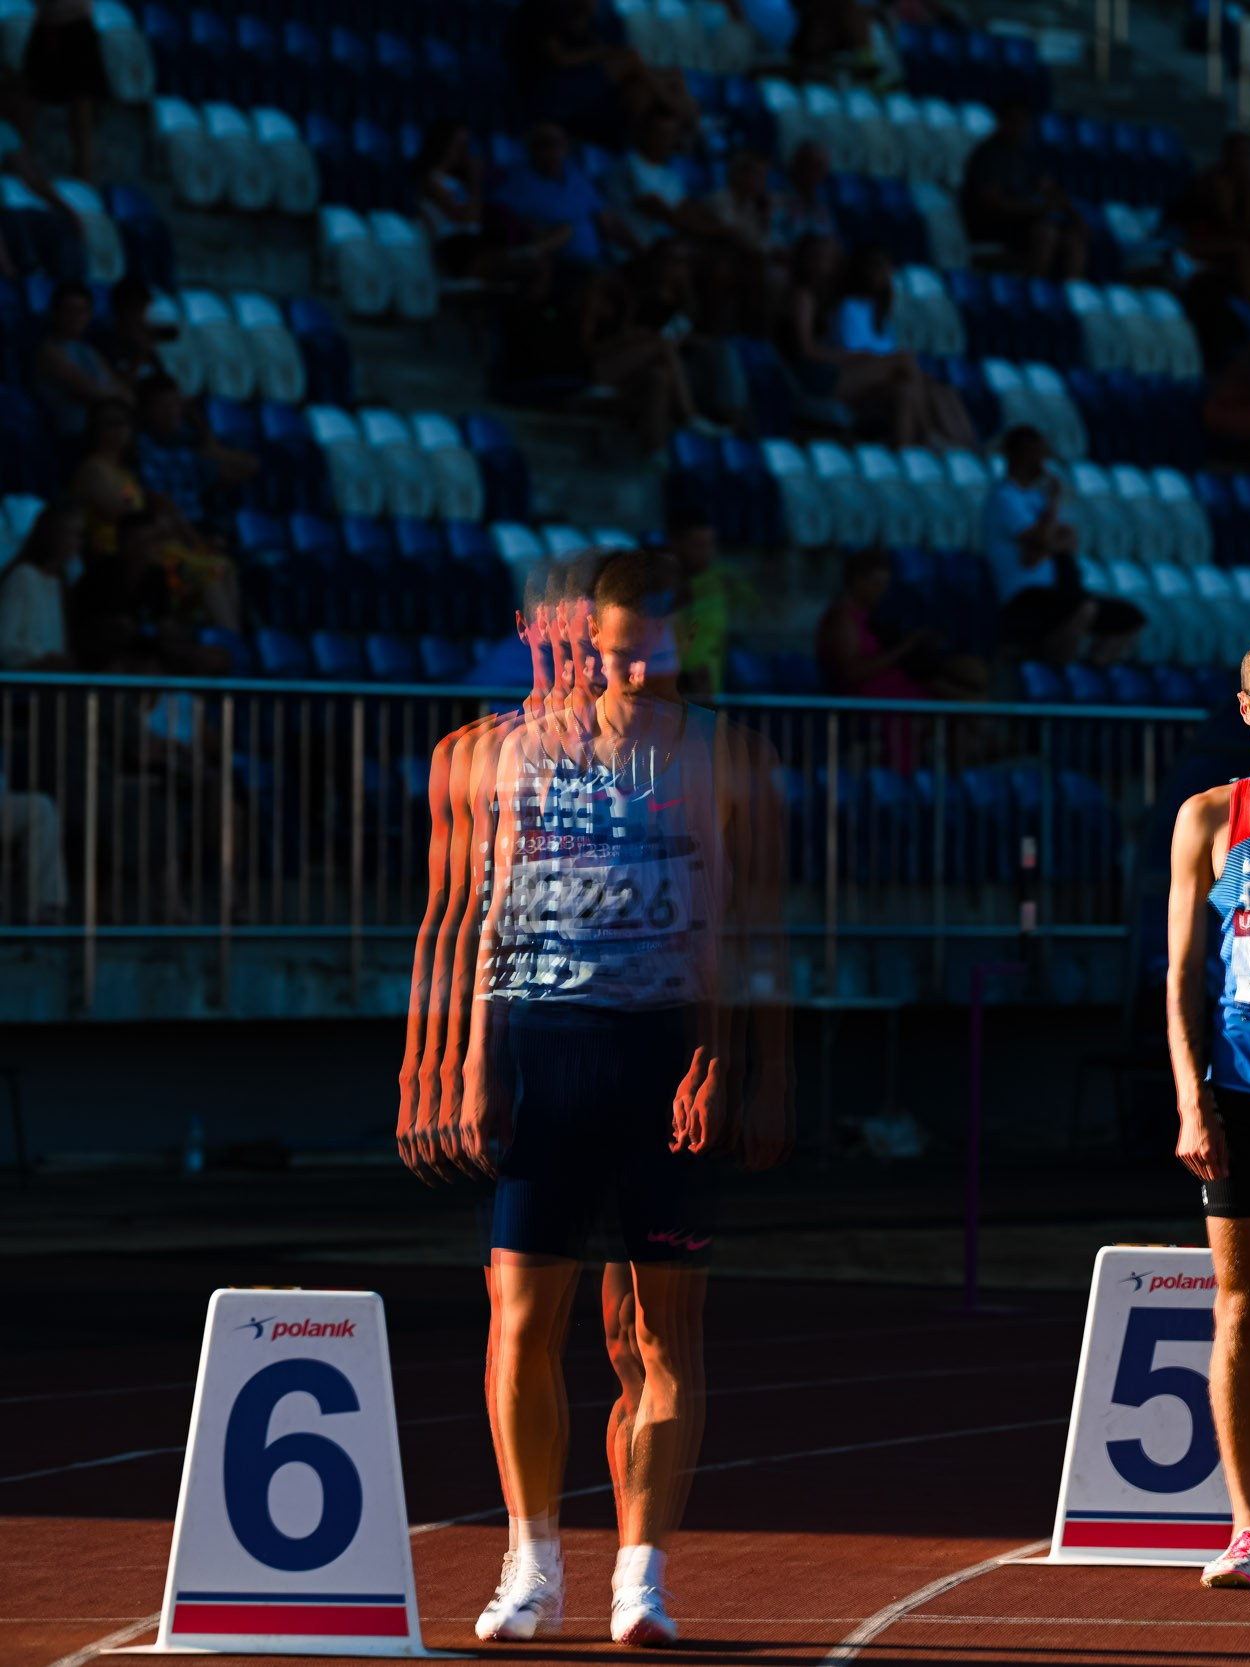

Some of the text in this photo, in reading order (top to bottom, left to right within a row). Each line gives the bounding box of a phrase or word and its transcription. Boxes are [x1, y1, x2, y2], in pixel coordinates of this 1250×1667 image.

[271, 1319, 357, 1341] polanik
[1106, 1306, 1221, 1494] 5
[224, 1358, 363, 1572] 6
